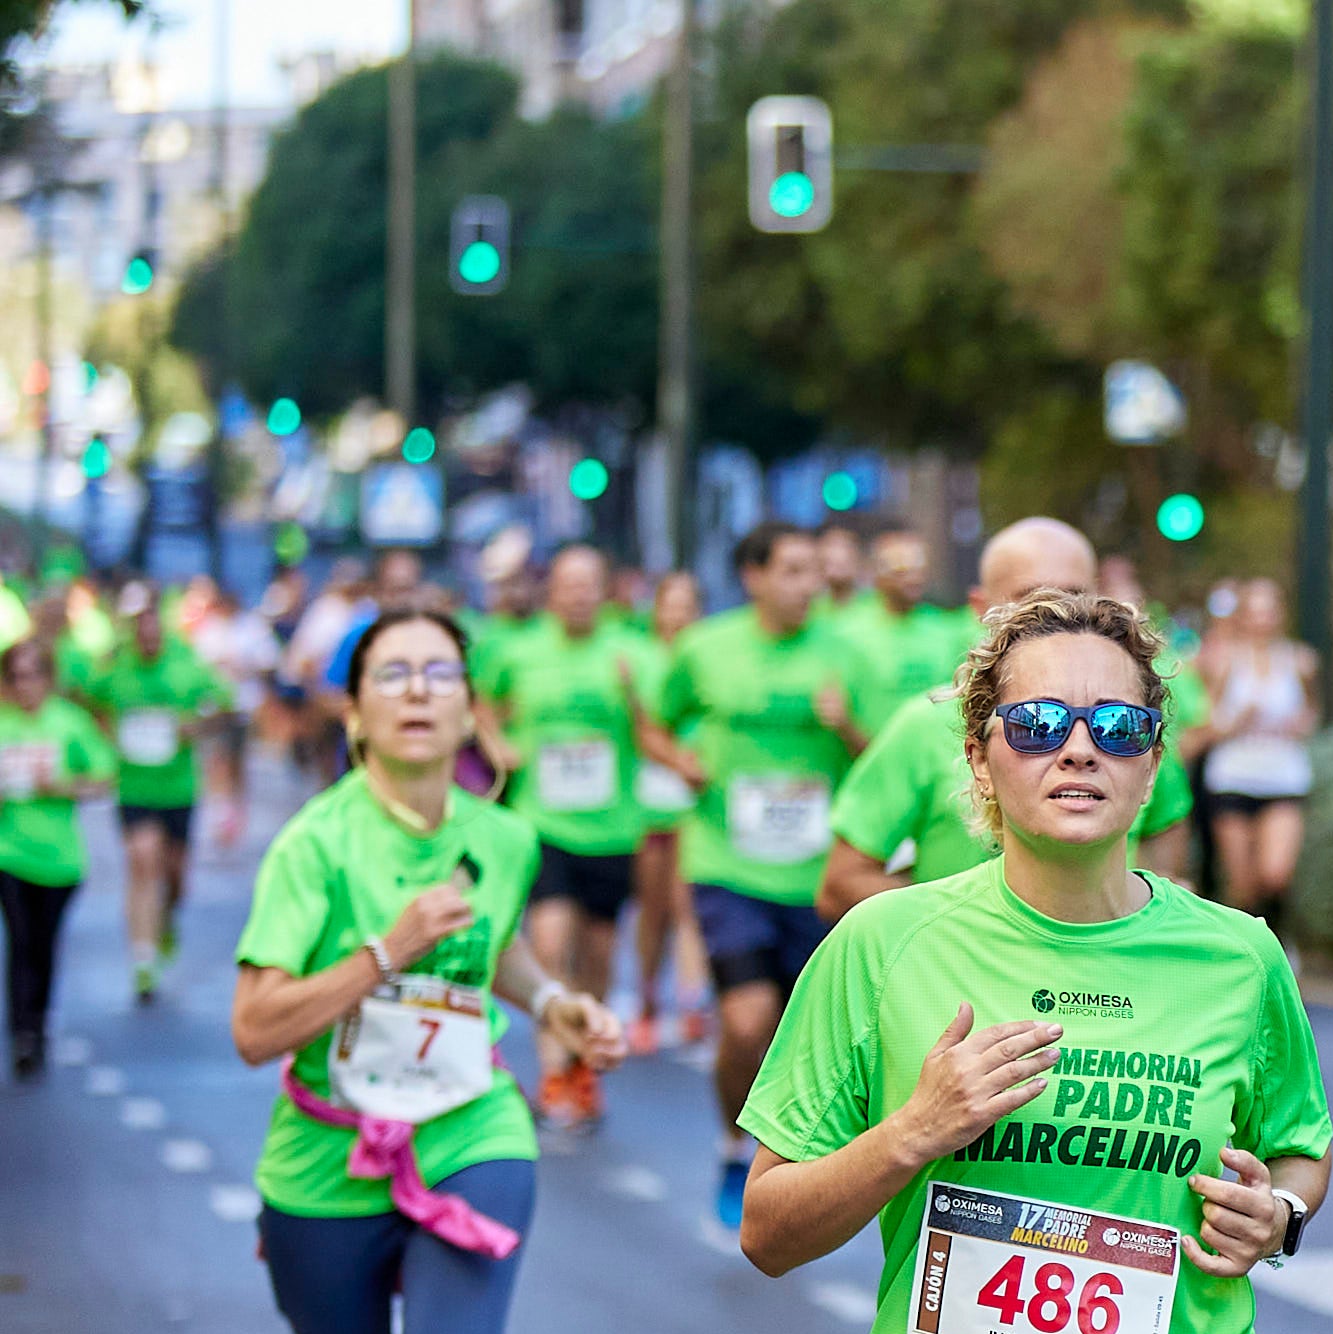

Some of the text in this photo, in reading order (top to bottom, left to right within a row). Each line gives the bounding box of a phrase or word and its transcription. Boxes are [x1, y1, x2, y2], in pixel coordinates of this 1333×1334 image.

[1059, 991, 1133, 1009] OXIMESA
[1058, 1007, 1134, 1019] NIPPON GASES
[418, 1018, 440, 1061] 7
[1052, 1047, 1201, 1089] MEMORIAL
[1053, 1079, 1195, 1130] PADRE
[950, 1209, 1003, 1225] NIPPON GASES
[952, 1198, 1003, 1217] OXIMESA
[1017, 1203, 1047, 1230] 17
[1044, 1207, 1092, 1227] MEMORIAL
[1042, 1219, 1088, 1240] PADRE
[1121, 1231, 1173, 1249] OXIMESA
[1010, 1227, 1089, 1255] MARCELINO
[925, 1251, 946, 1312] CAJÓN 4
